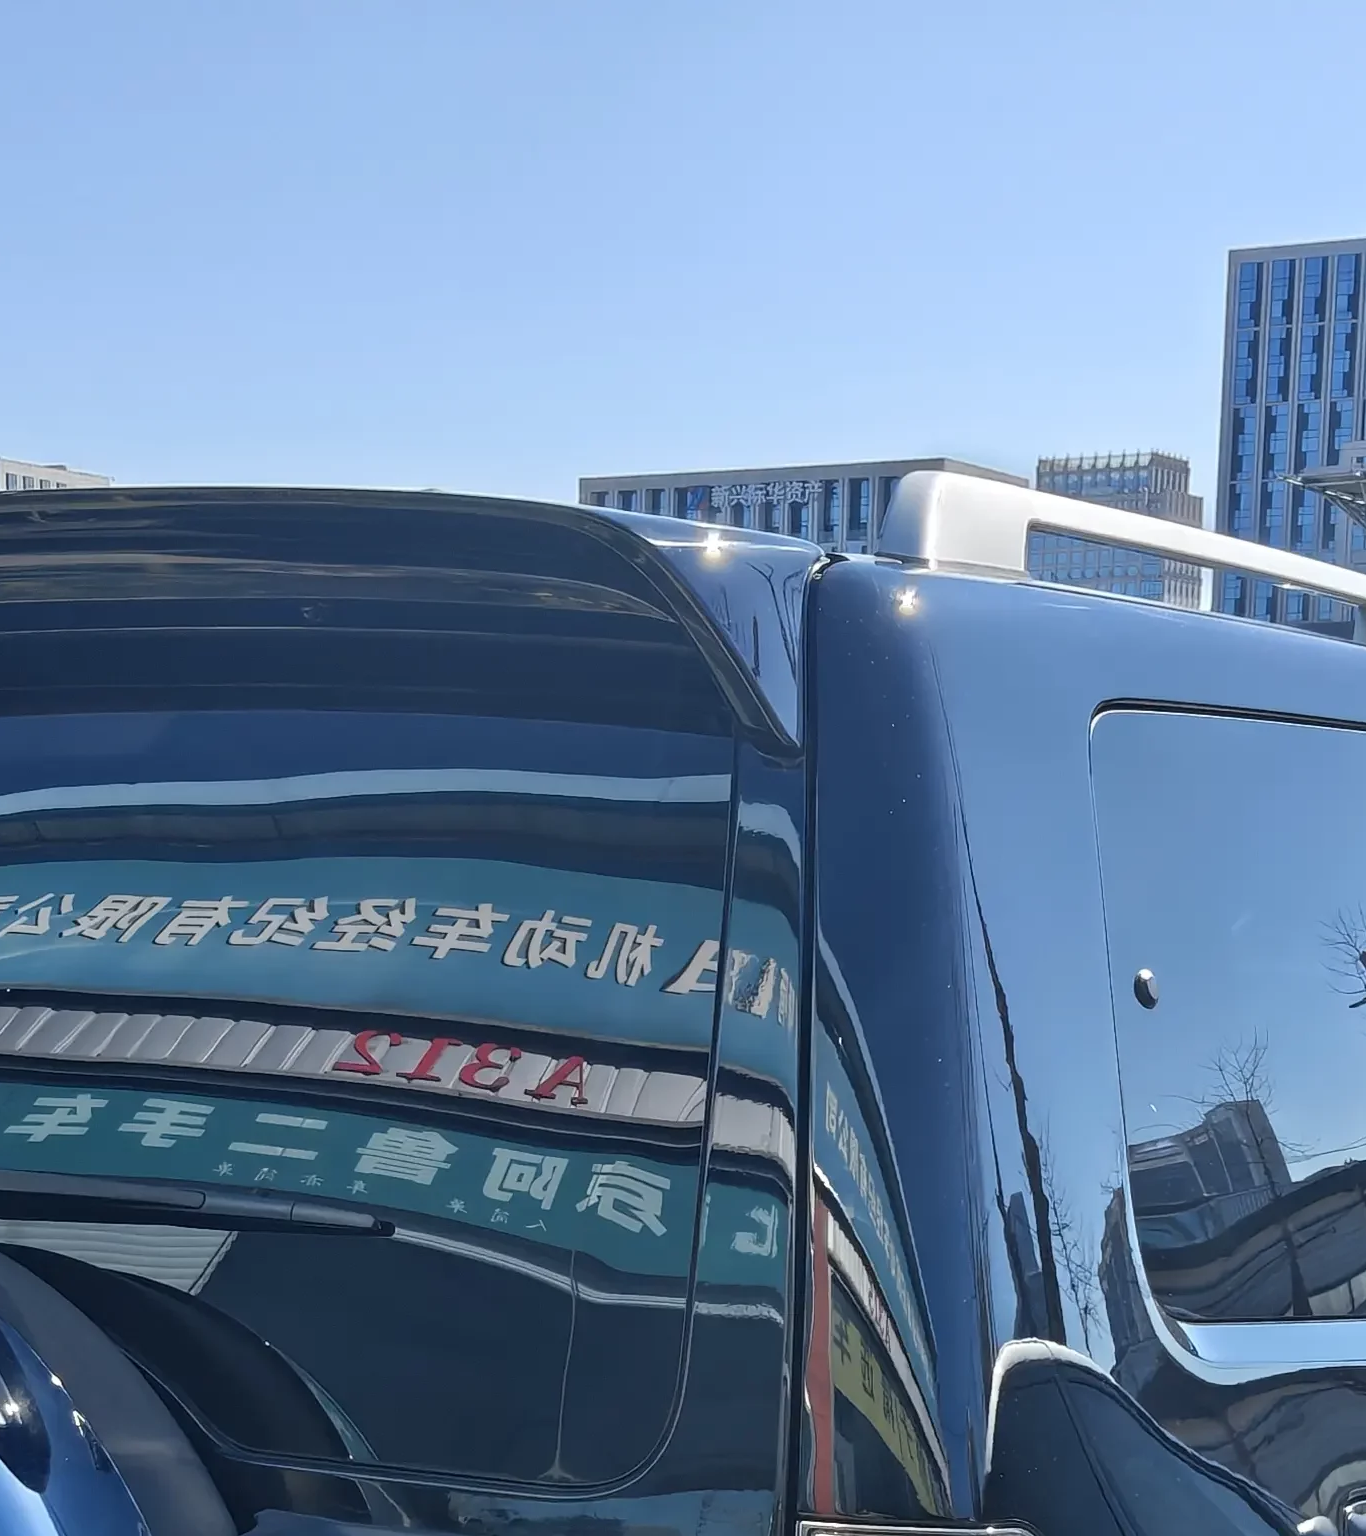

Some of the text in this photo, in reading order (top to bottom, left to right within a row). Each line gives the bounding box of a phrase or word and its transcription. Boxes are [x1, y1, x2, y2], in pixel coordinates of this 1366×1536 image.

[710, 480, 823, 509] 新兴际华资产
